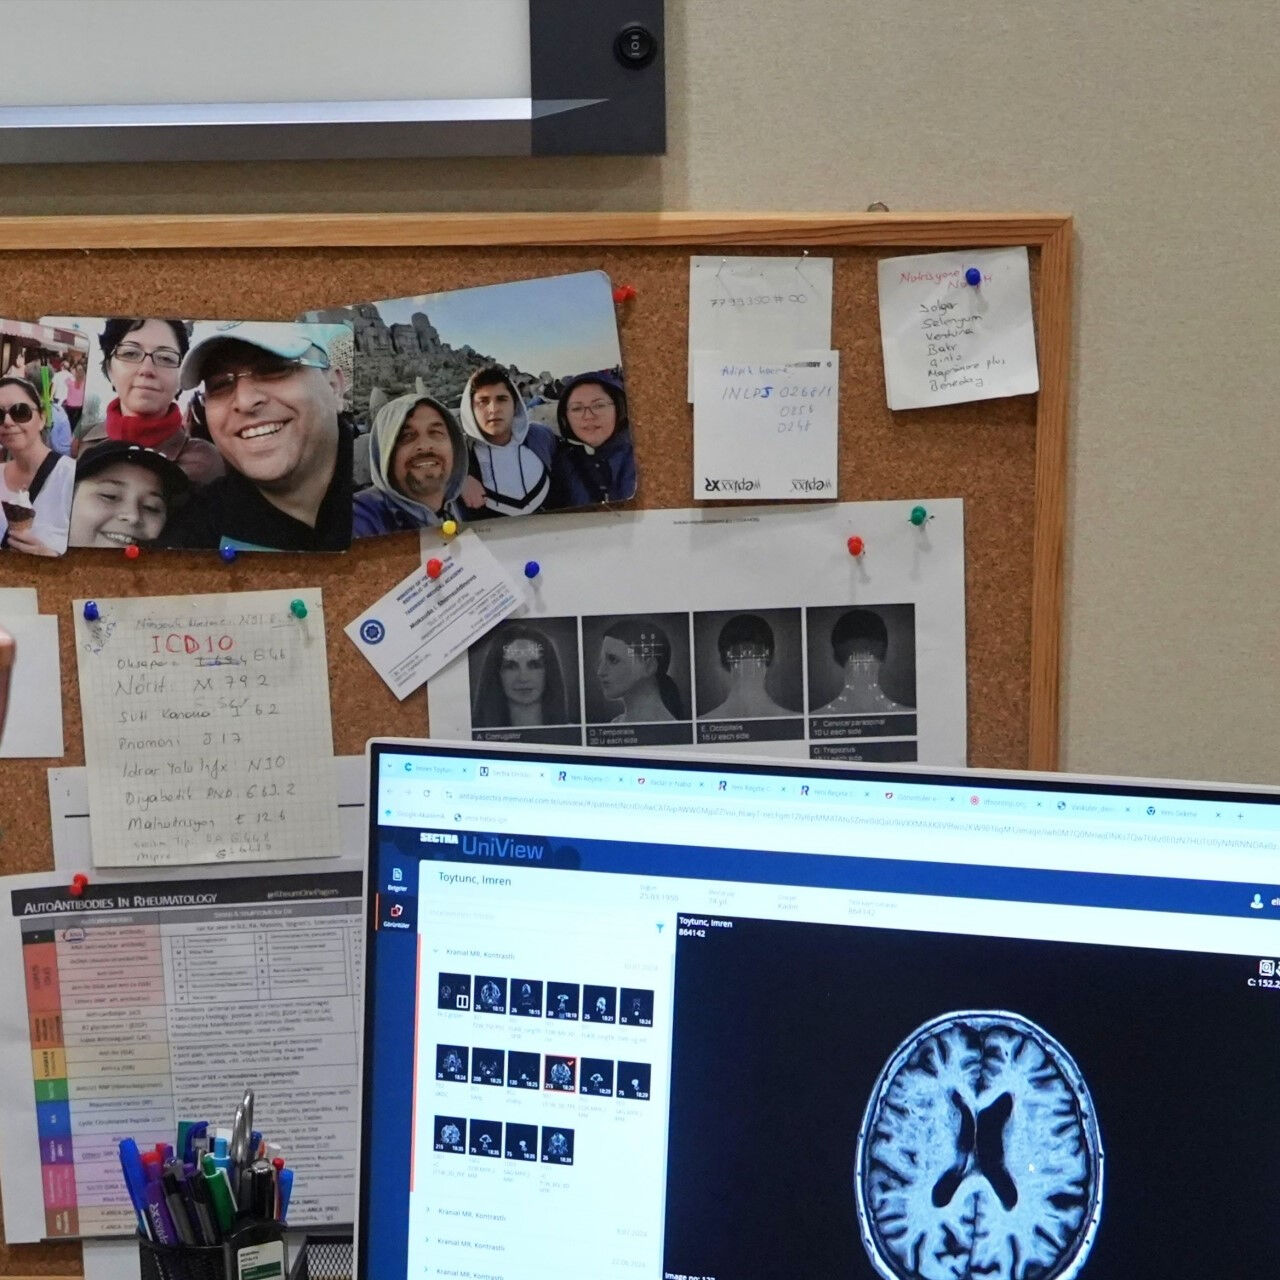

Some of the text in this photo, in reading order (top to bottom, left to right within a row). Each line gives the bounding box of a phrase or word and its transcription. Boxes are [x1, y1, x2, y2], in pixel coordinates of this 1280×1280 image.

[420, 832, 459, 844] SECTRA
[462, 834, 544, 860] UniView
[438, 871, 479, 886] Toytunc,
[679, 916, 733, 928] Toytunc, Imren
[678, 928, 706, 938] 864142
[1247, 978, 1256, 987] C:
[438, 1207, 461, 1217] Kranial
[437, 1237, 460, 1247] Kranial
[436, 1268, 459, 1277] Kranial
